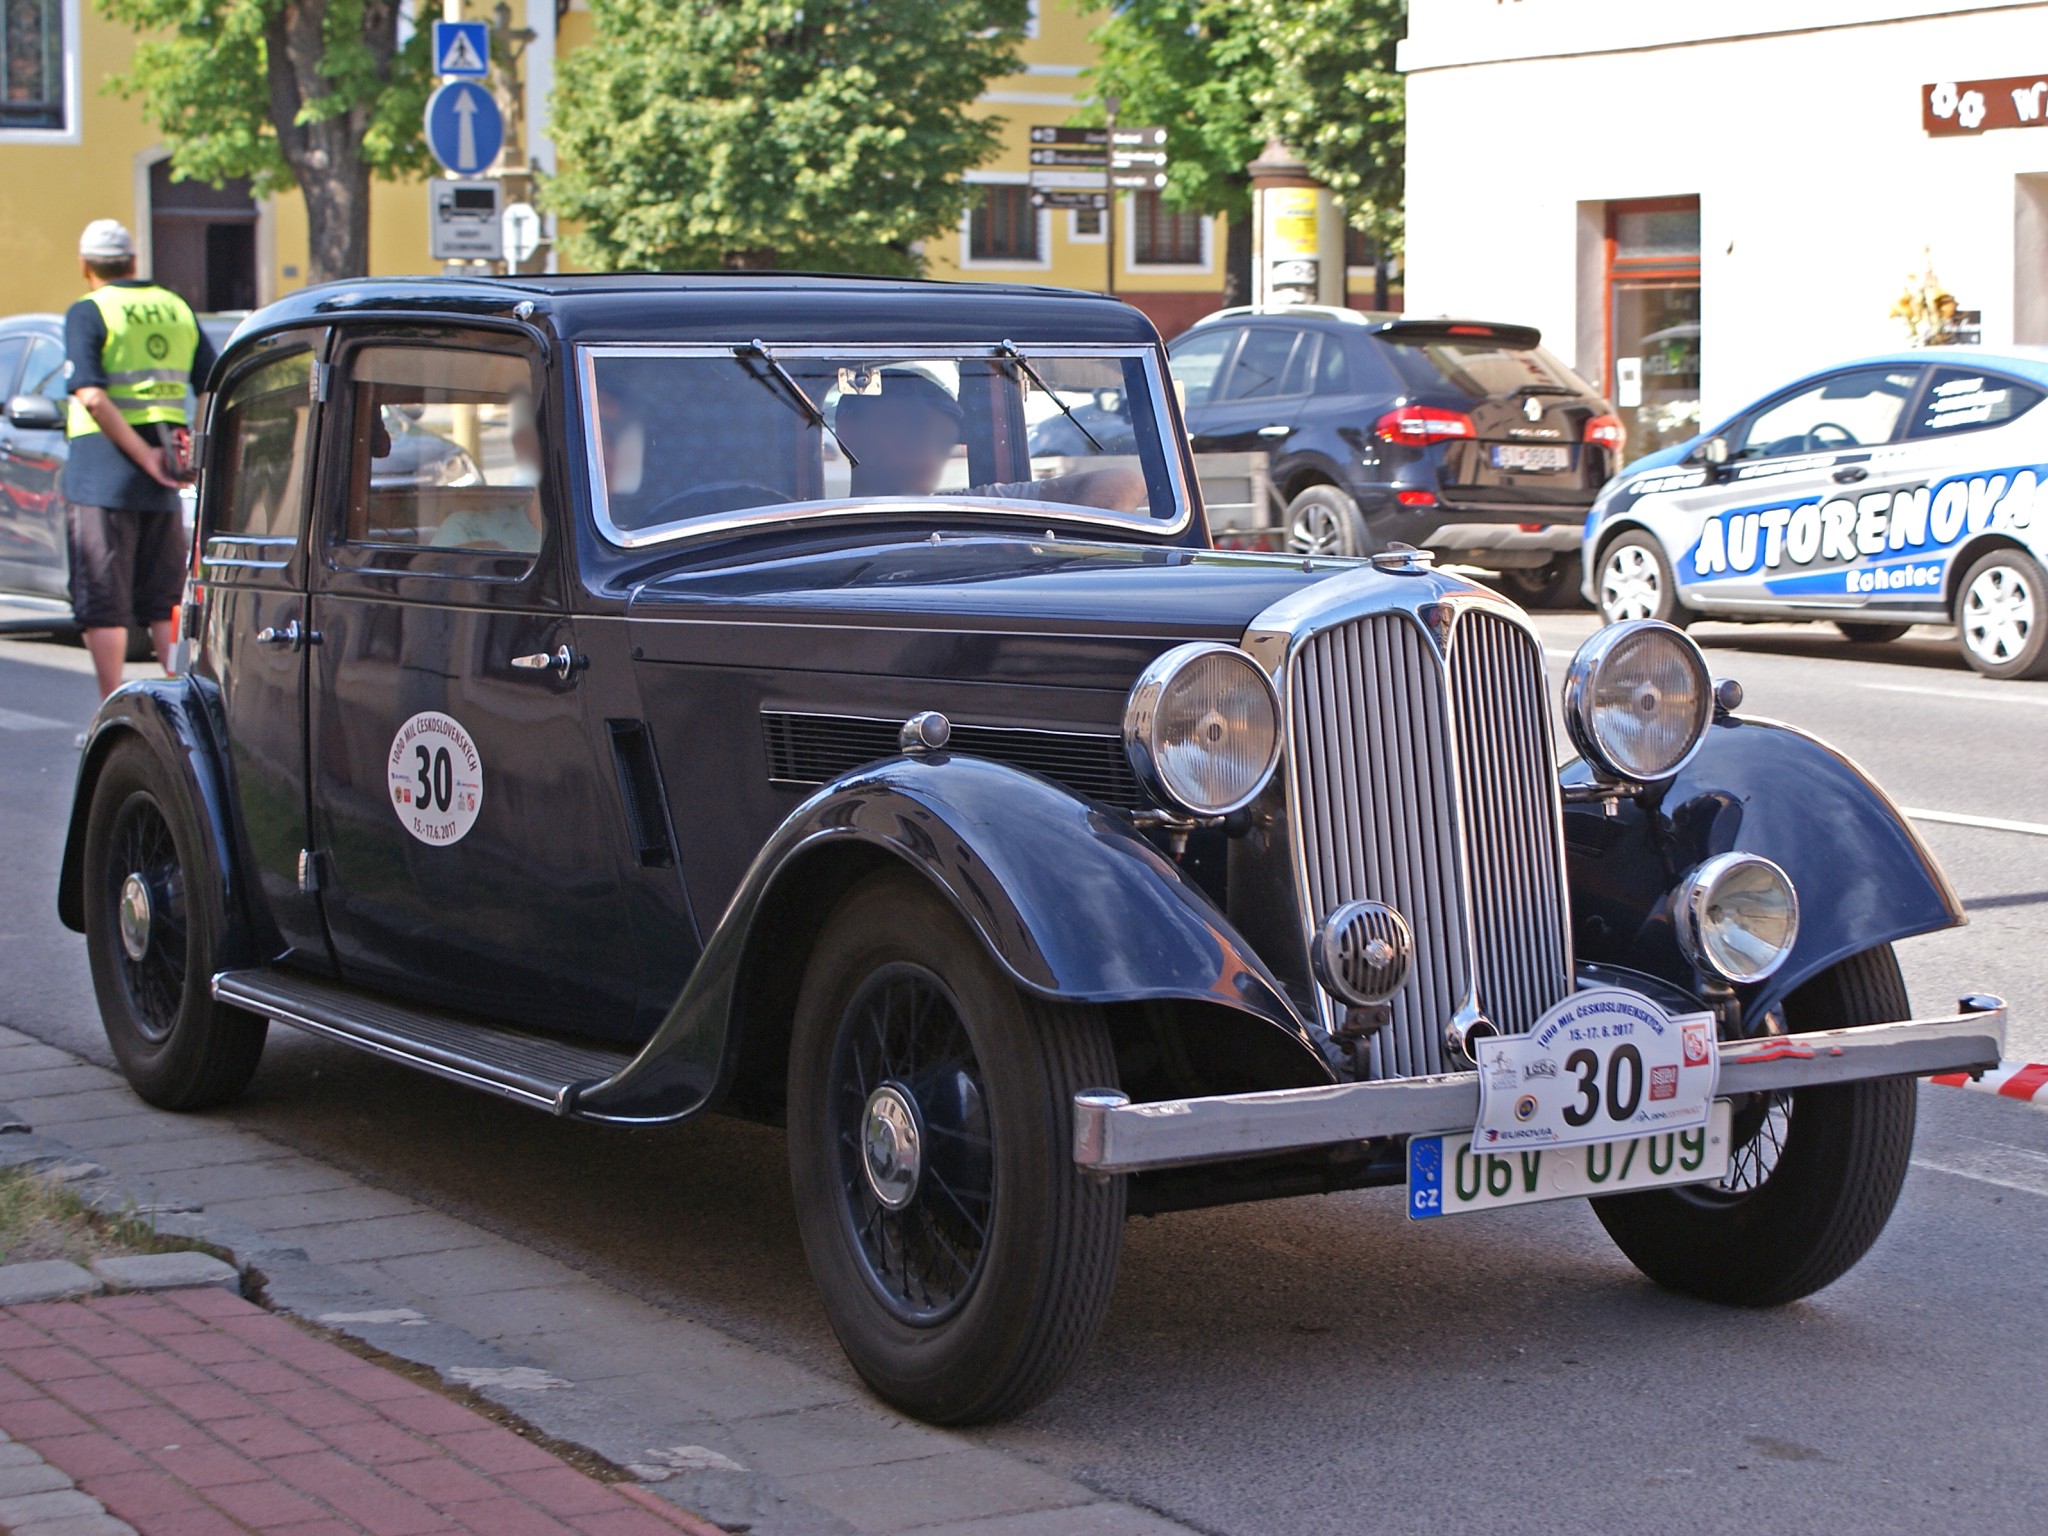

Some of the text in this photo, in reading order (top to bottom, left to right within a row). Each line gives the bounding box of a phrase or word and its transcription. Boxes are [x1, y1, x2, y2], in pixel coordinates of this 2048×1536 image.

[2011, 81, 2048, 121] W
[1694, 469, 2038, 576] AUTORENOVA
[1846, 564, 1941, 593] Rohatec
[404, 722, 417, 743] MIL
[417, 717, 478, 771] ČESKOSLOVENSKÝCH
[416, 744, 453, 813] 30
[1558, 1012, 1575, 1028] MIL
[1561, 1042, 1643, 1128] 30
[1500, 1127, 1552, 1140] EUROVIA
[1414, 1188, 1440, 1210] CZ
